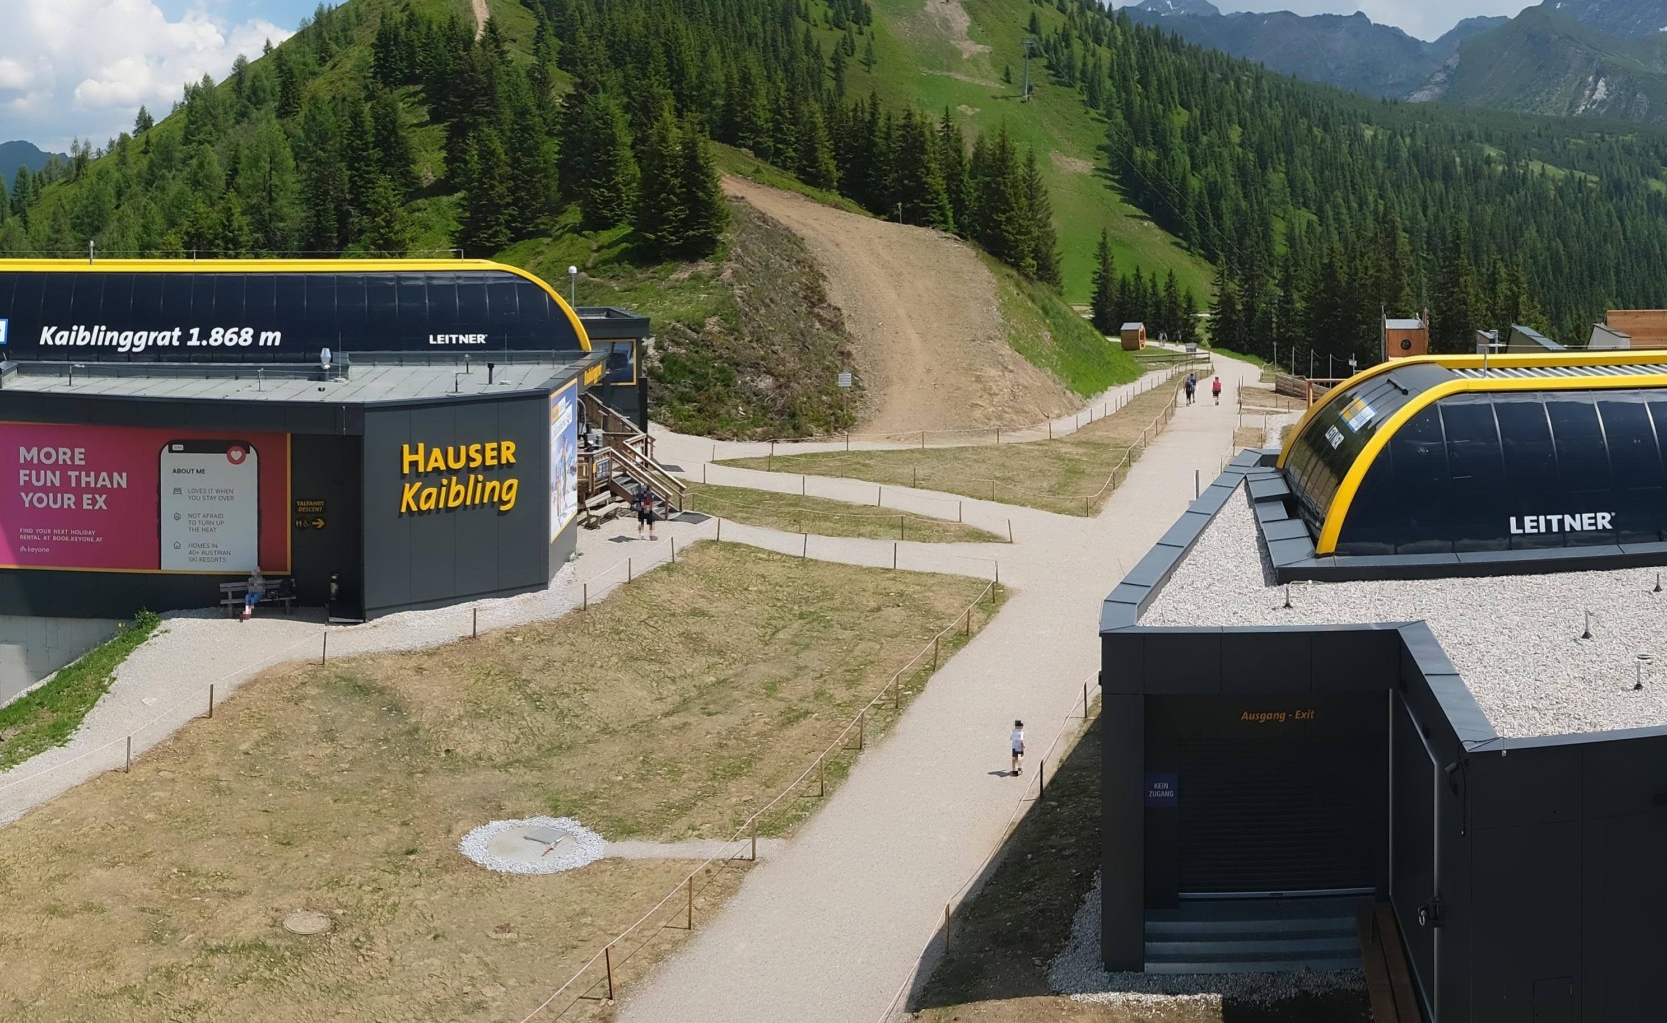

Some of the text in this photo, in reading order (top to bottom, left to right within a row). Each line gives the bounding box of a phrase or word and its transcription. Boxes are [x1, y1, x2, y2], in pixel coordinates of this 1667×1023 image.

[39, 325, 281, 352] Kaiblinggrat 1.868 m
[429, 333, 487, 345] LEITNER
[19, 446, 86, 465] MORE
[401, 440, 517, 475] HAUSER
[19, 469, 128, 489] FUN THAN
[20, 492, 108, 510] YOUR EX
[400, 474, 519, 513] Kaibling
[1509, 512, 1614, 534] LEITNER
[1240, 710, 1286, 723] Ausgang
[1295, 709, 1315, 720] Exit
[1148, 790, 1174, 798] ZUGANG
[1153, 782, 1169, 790] KEIN
